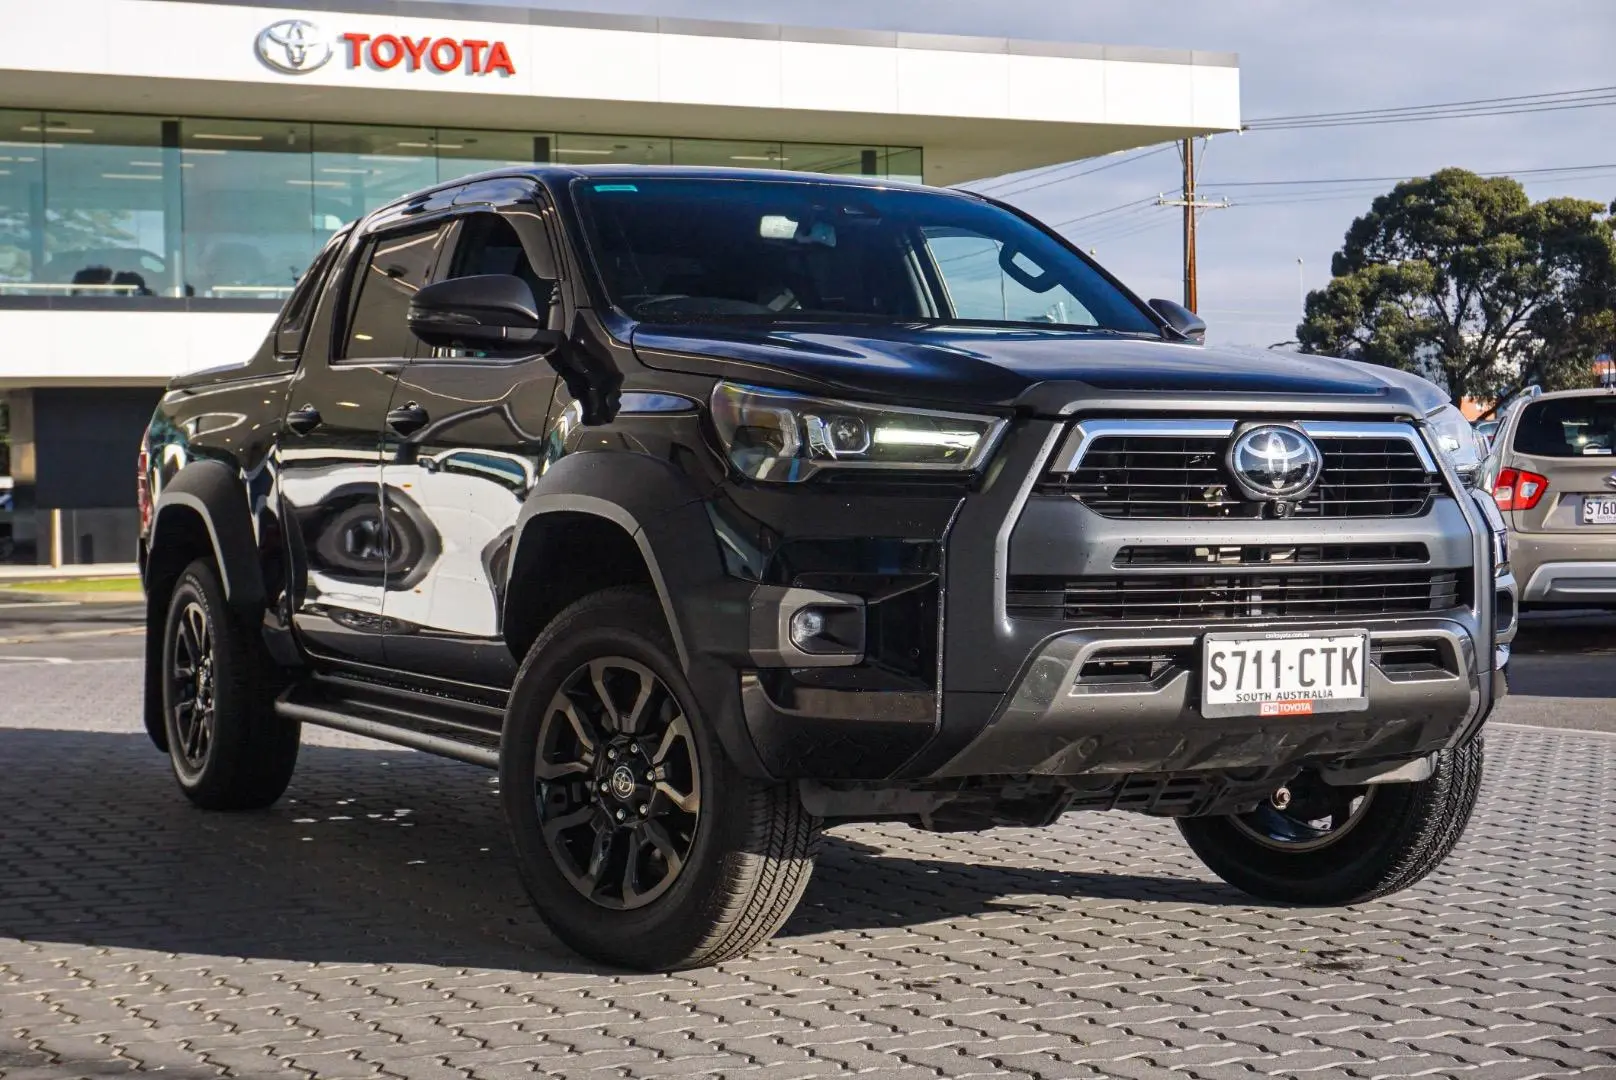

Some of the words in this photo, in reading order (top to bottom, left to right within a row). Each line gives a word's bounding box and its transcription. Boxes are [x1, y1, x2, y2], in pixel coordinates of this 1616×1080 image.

[343, 33, 516, 75] TOYOTA
[1236, 692, 1272, 702] SOUTH
[1276, 690, 1334, 700] AUSTRALIA
[1280, 703, 1311, 712] TOYOTA
